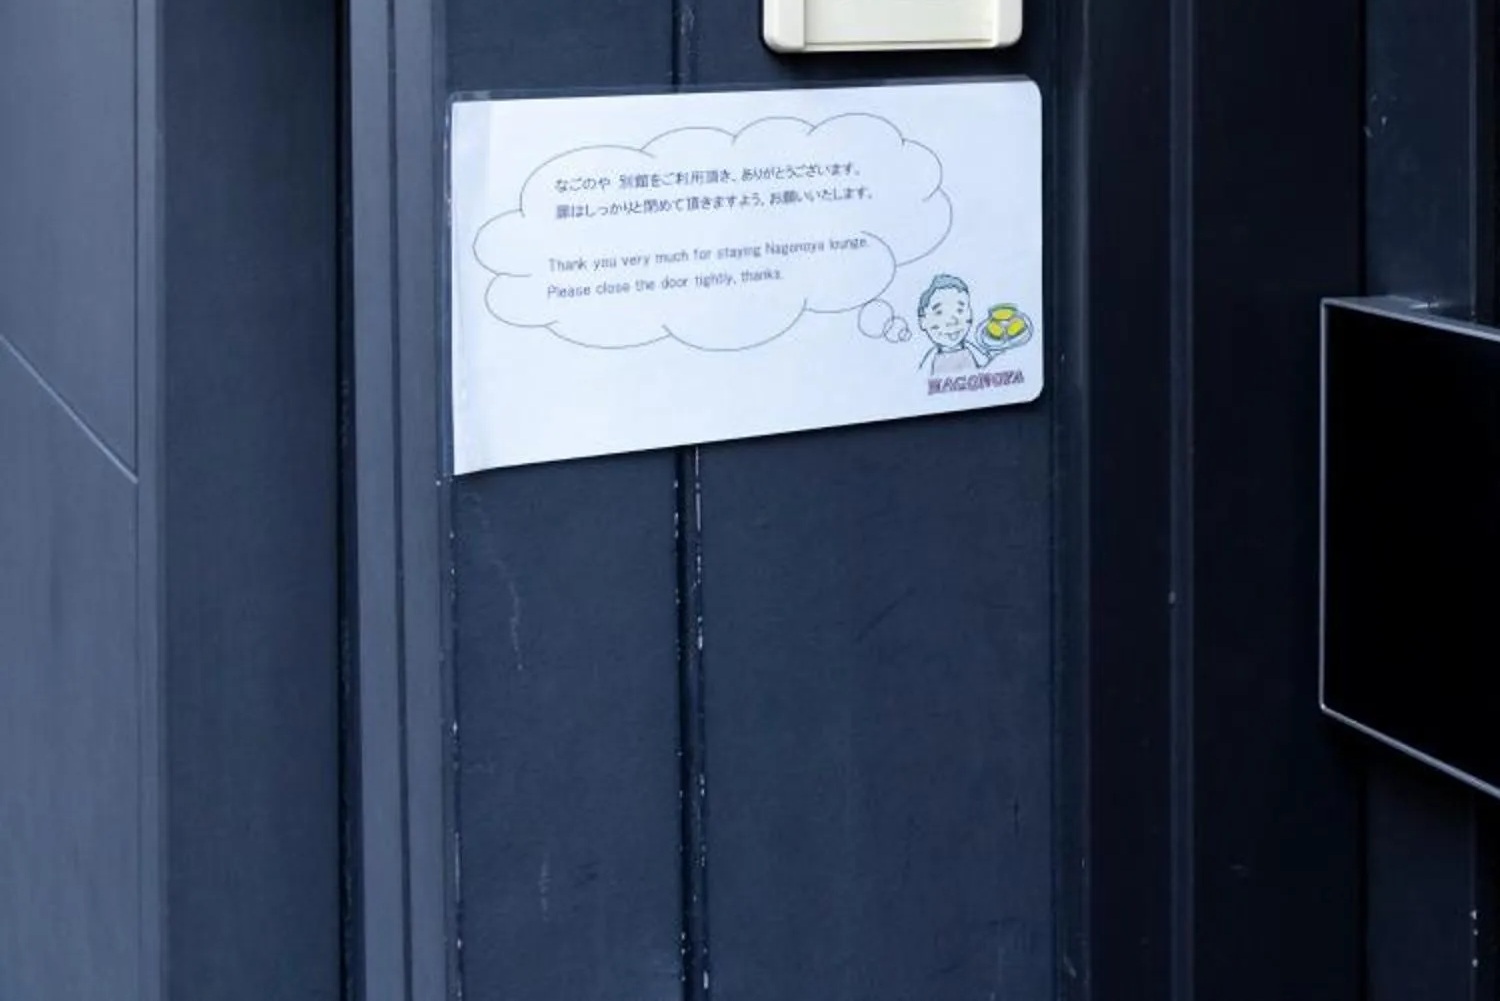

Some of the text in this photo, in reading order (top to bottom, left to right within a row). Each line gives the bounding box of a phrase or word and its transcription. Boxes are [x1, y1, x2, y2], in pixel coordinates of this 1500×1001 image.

[555, 176, 611, 193] なごのや
[549, 235, 869, 272] Thank you very much for staying Nagonoya lounge.
[547, 267, 783, 299] Please close the door tightly, thanks.
[928, 370, 1024, 395] NAGONOYA
